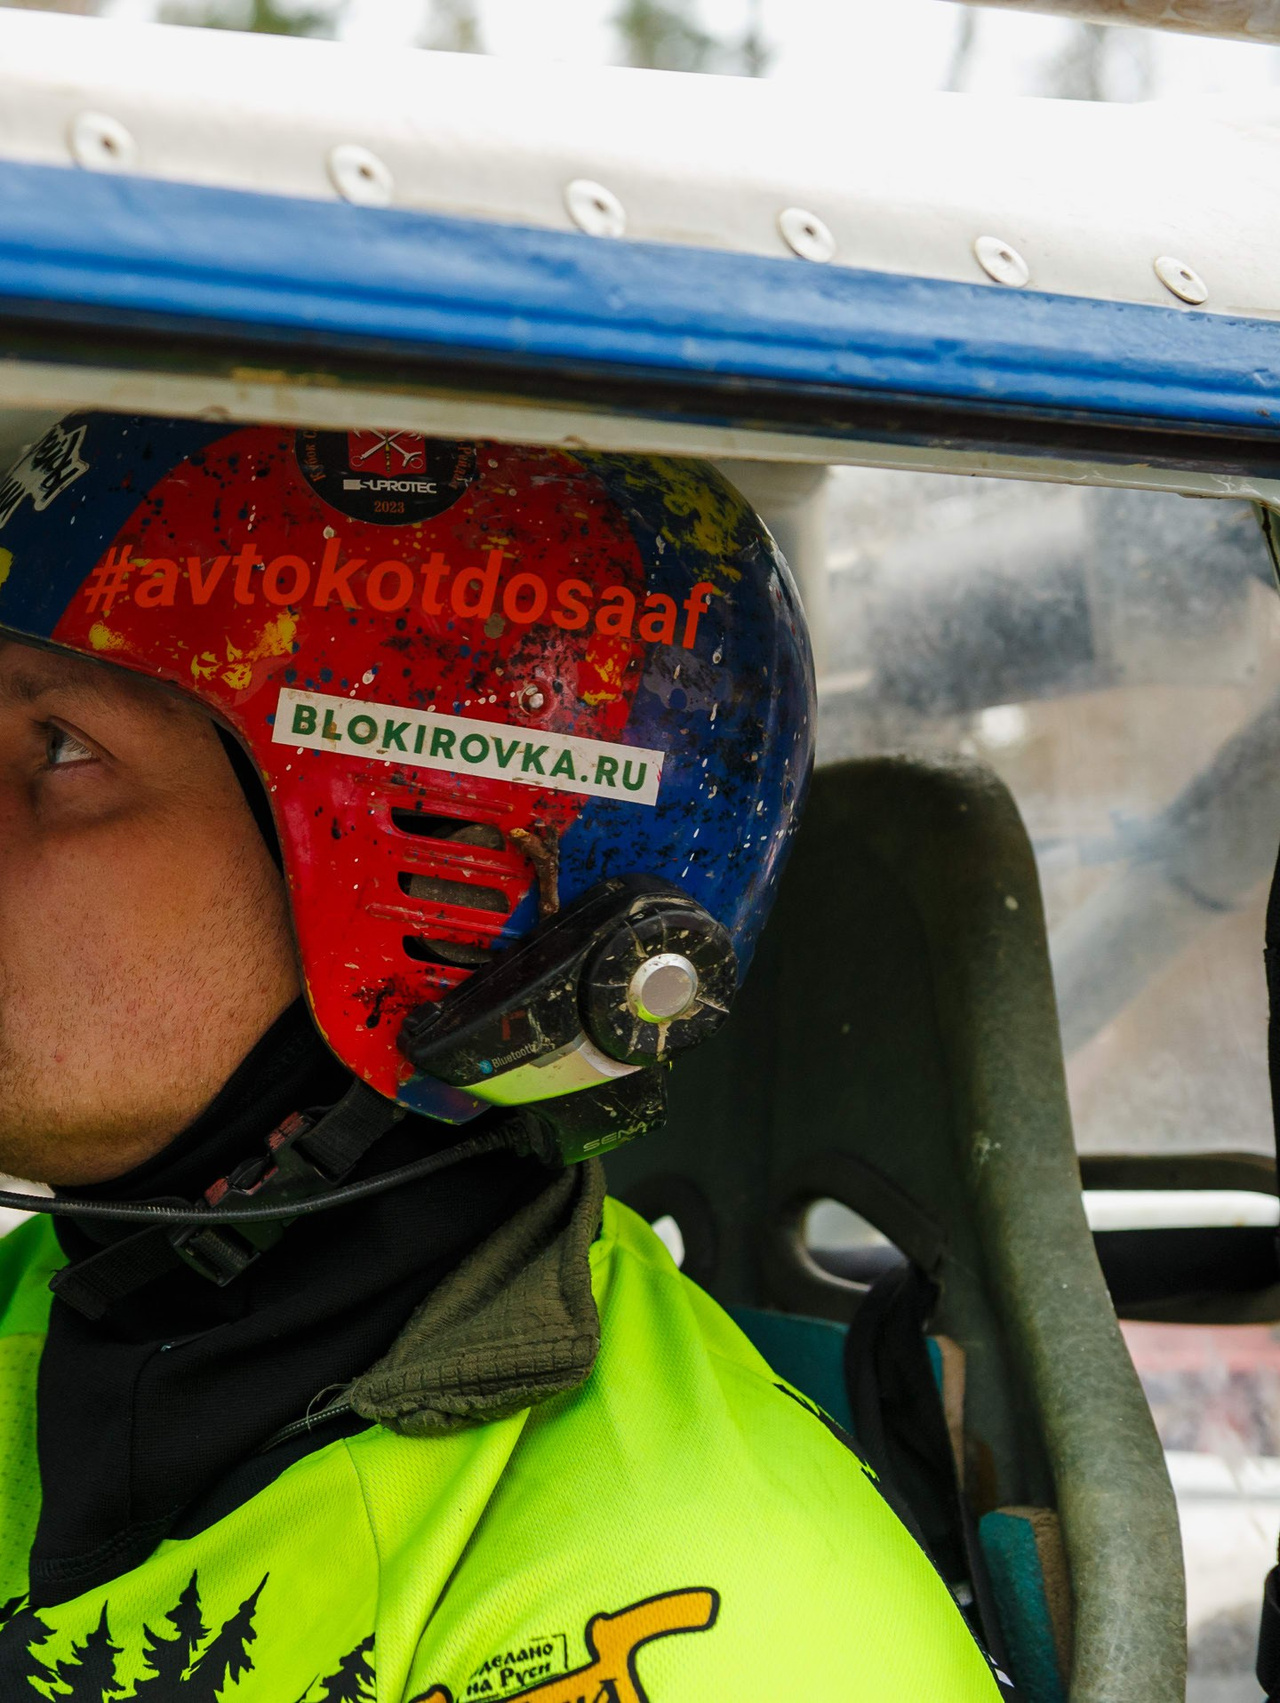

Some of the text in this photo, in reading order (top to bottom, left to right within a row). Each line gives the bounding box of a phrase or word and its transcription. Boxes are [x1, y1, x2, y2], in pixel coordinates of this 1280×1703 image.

[359, 478, 438, 495] SUPROTEC
[373, 500, 406, 514] 2023
[83, 535, 714, 651] #avtokotdosaaf
[290, 703, 650, 793] BLOKIROVKA.RU
[582, 1121, 648, 1153] SENA
[466, 1662, 551, 1697] на Руси
